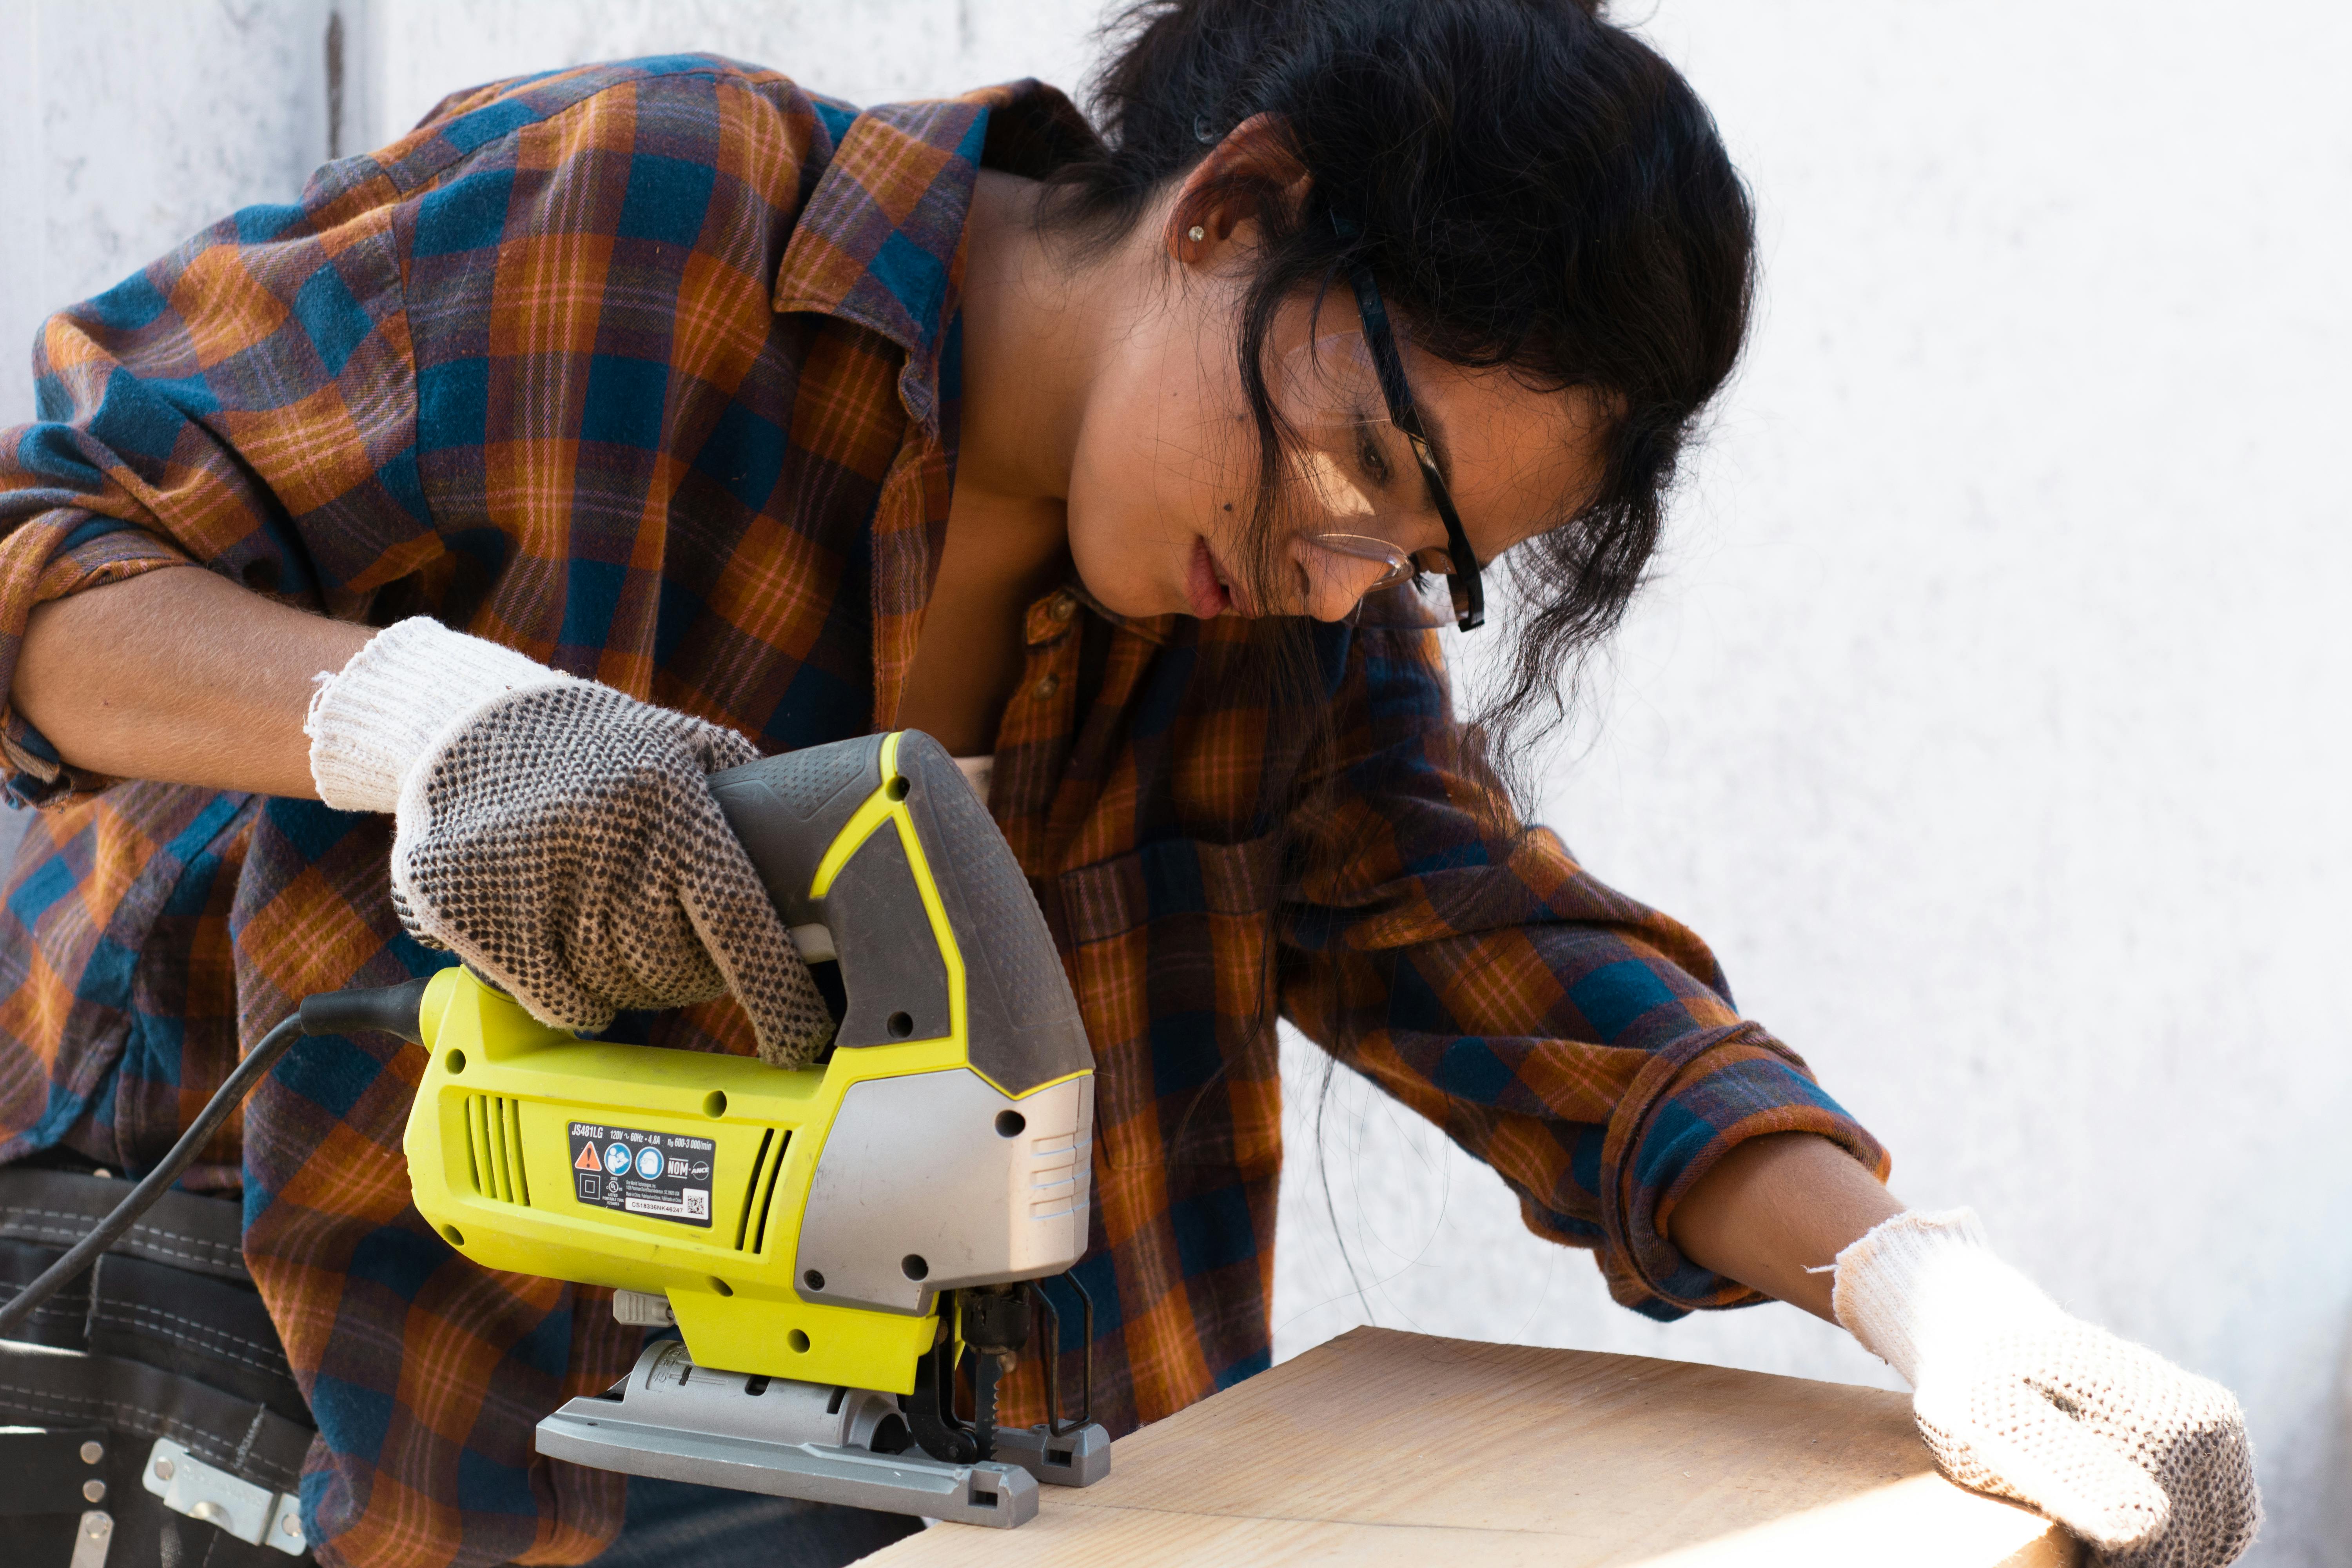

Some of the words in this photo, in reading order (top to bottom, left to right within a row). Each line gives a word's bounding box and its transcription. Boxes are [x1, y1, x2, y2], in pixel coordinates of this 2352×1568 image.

[572, 1124, 603, 1138] JS481LG
[610, 1130, 623, 1140] 120V
[630, 1132, 644, 1143] 60Hz
[648, 1134, 660, 1145] 4,8A
[668, 1160, 688, 1176] NOM
[632, 1202, 683, 1213] CS18336NK46247
